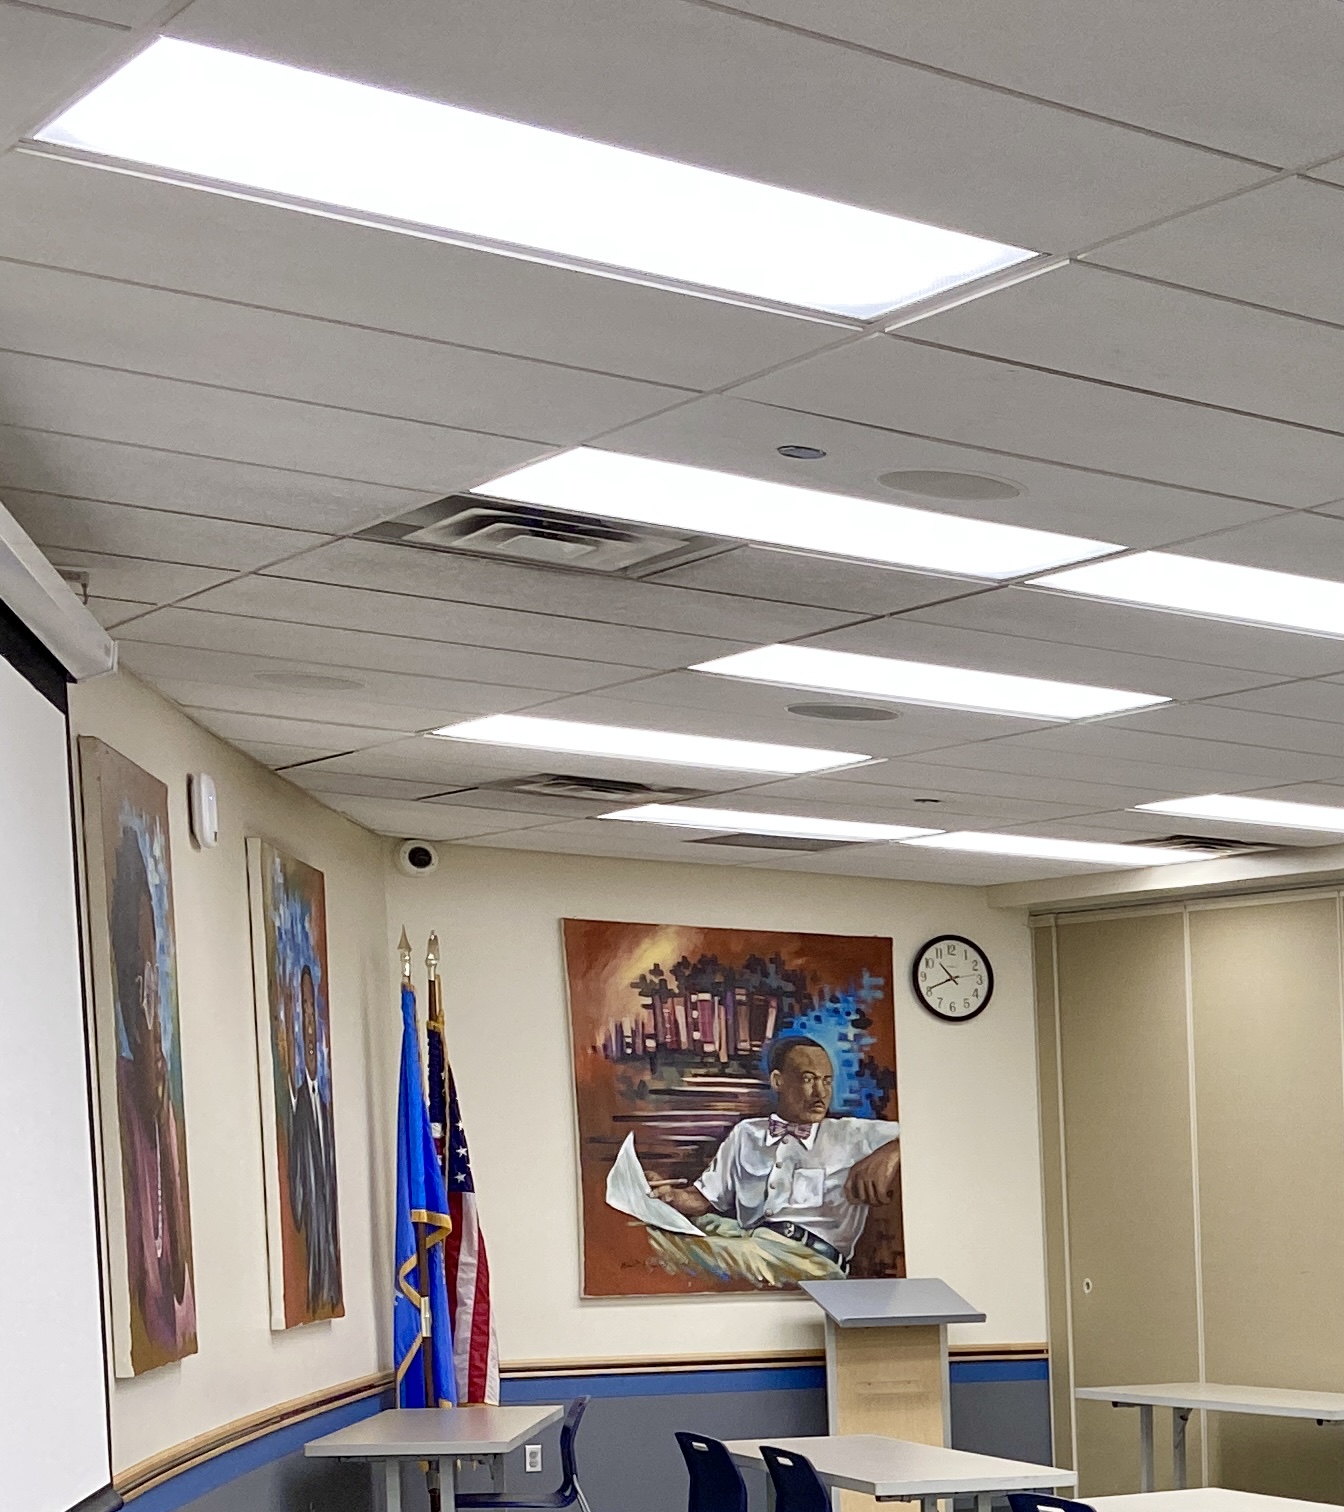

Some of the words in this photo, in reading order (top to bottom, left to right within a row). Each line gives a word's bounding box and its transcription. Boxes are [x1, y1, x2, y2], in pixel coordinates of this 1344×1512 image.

[935, 948, 942, 959] 11
[947, 944, 956, 956] 12
[925, 958, 934, 969] 10
[972, 960, 978, 971] 2
[921, 971, 926, 982] 9
[976, 974, 983, 985] 3
[926, 986, 932, 997] 8
[972, 988, 979, 999] 4
[937, 997, 943, 1008] 7
[950, 1002, 956, 1012] 6
[963, 998, 970, 1008] 5
